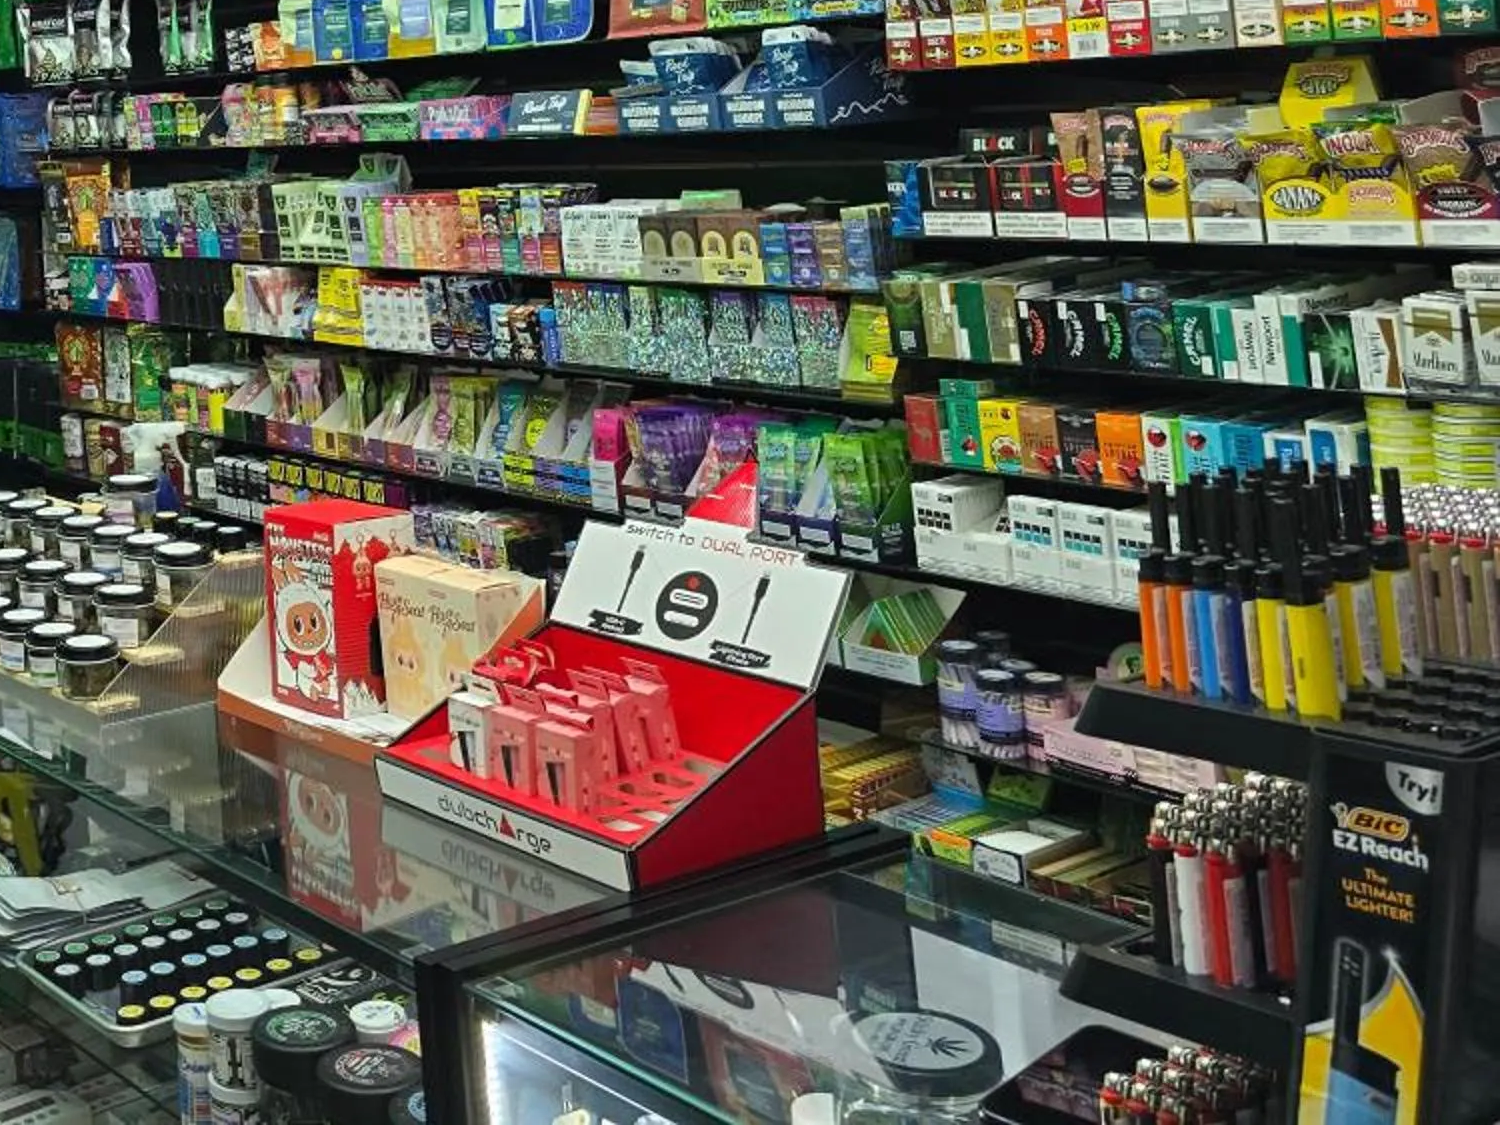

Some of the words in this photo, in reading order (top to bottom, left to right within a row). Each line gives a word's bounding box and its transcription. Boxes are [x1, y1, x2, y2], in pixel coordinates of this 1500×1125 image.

[679, 534, 695, 546] to
[701, 537, 745, 557] DUAL
[750, 547, 799, 566] PORT
[1396, 771, 1438, 804] Try!
[1332, 830, 1360, 853] EZ
[1362, 838, 1430, 871] Reach
[1365, 868, 1388, 883] The
[1341, 878, 1416, 907] ULTIMATE
[1344, 896, 1416, 924] LIGHTER!
